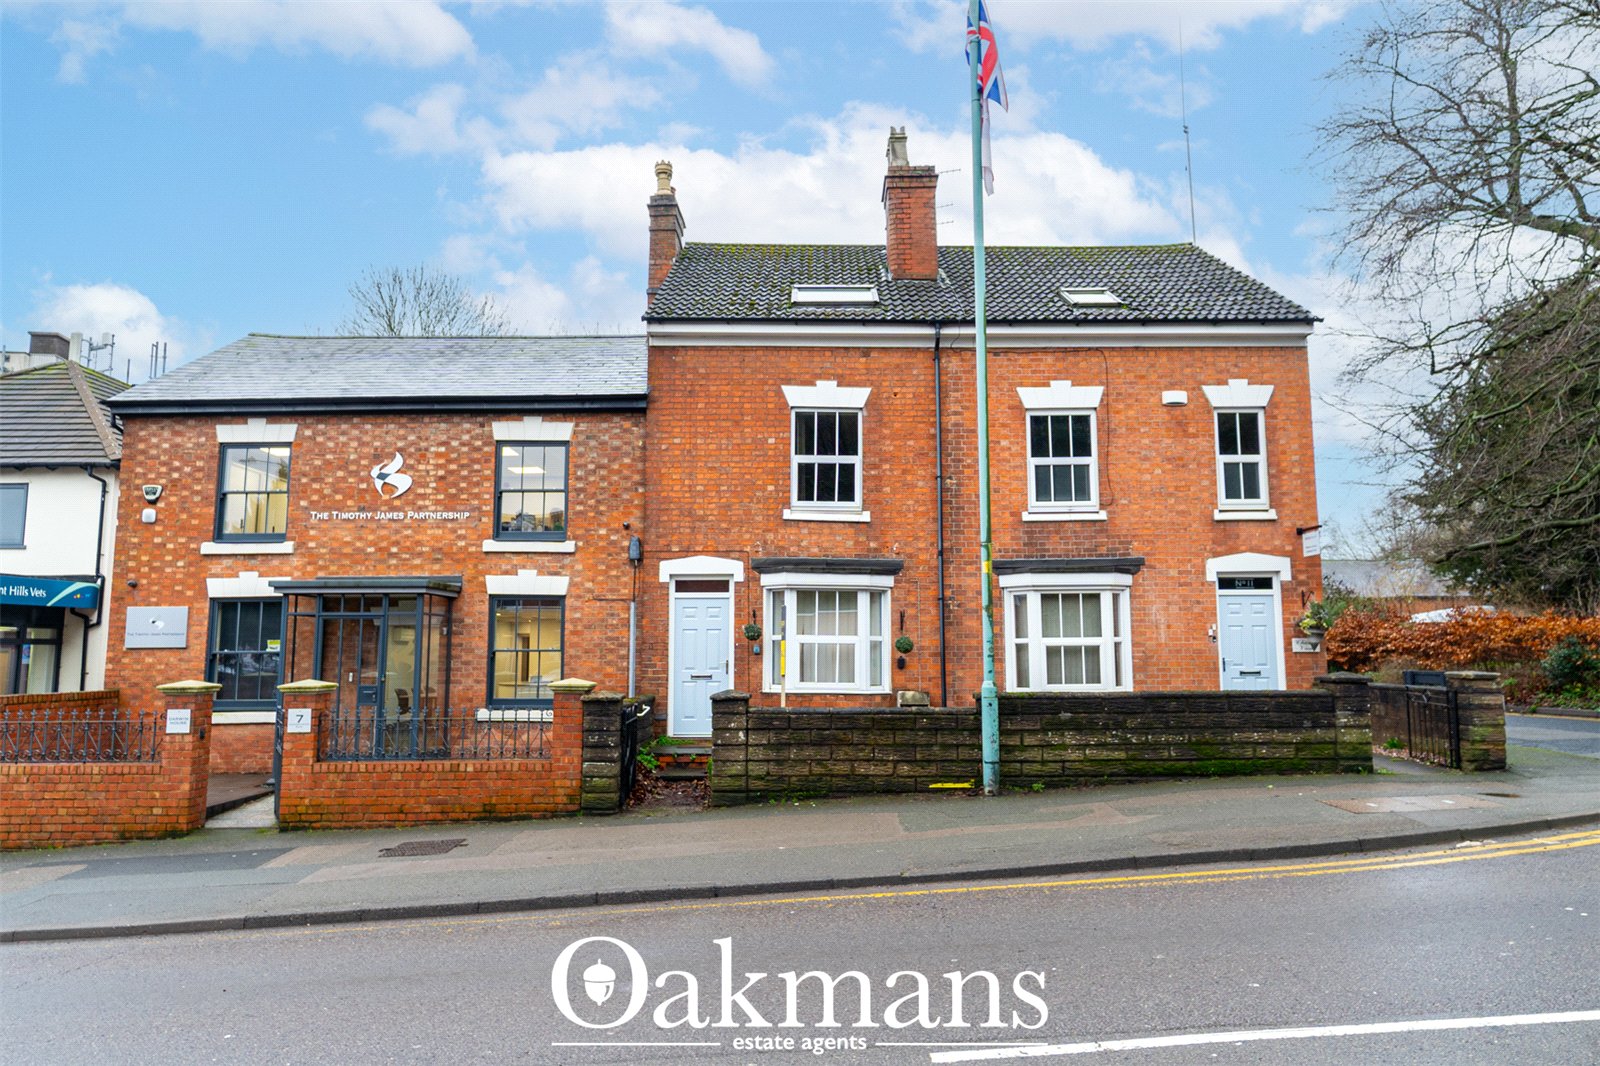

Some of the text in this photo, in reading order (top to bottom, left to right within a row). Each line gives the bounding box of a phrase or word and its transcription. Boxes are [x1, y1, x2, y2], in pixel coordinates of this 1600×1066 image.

[332, 511, 371, 520] TIMOTHY
[374, 511, 404, 519] JAMES
[407, 511, 470, 519] PARTNERSHIP
[9, 585, 29, 597] Hills
[30, 587, 47, 598] Vets
[296, 714, 304, 723] 7
